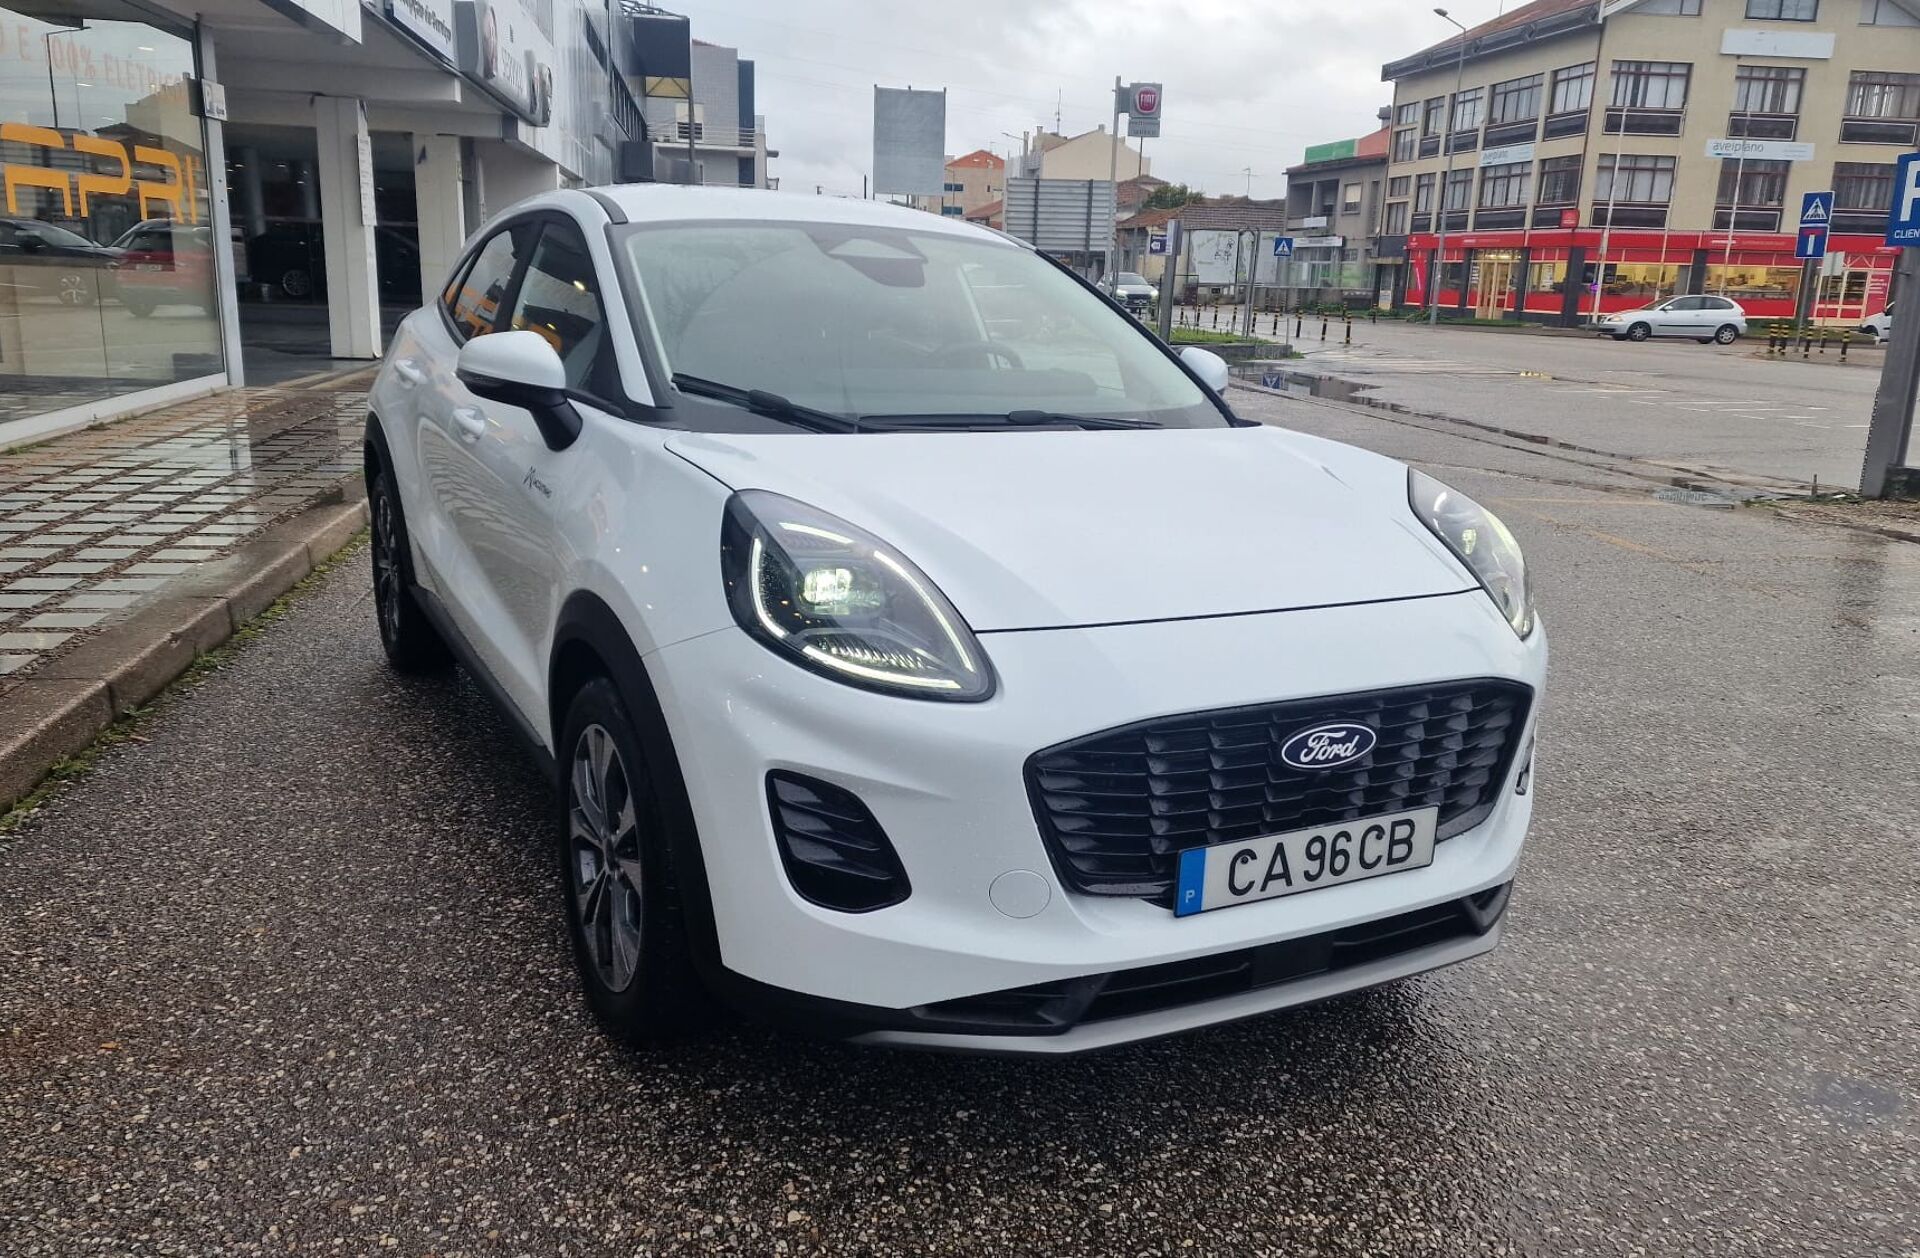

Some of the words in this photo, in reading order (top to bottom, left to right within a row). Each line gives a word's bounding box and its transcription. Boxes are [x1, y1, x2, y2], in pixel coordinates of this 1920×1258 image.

[1140, 94, 1155, 106] FIAT
[1712, 141, 1764, 153] aveipano
[1300, 731, 1360, 762] Ford
[1185, 890, 1195, 903] P
